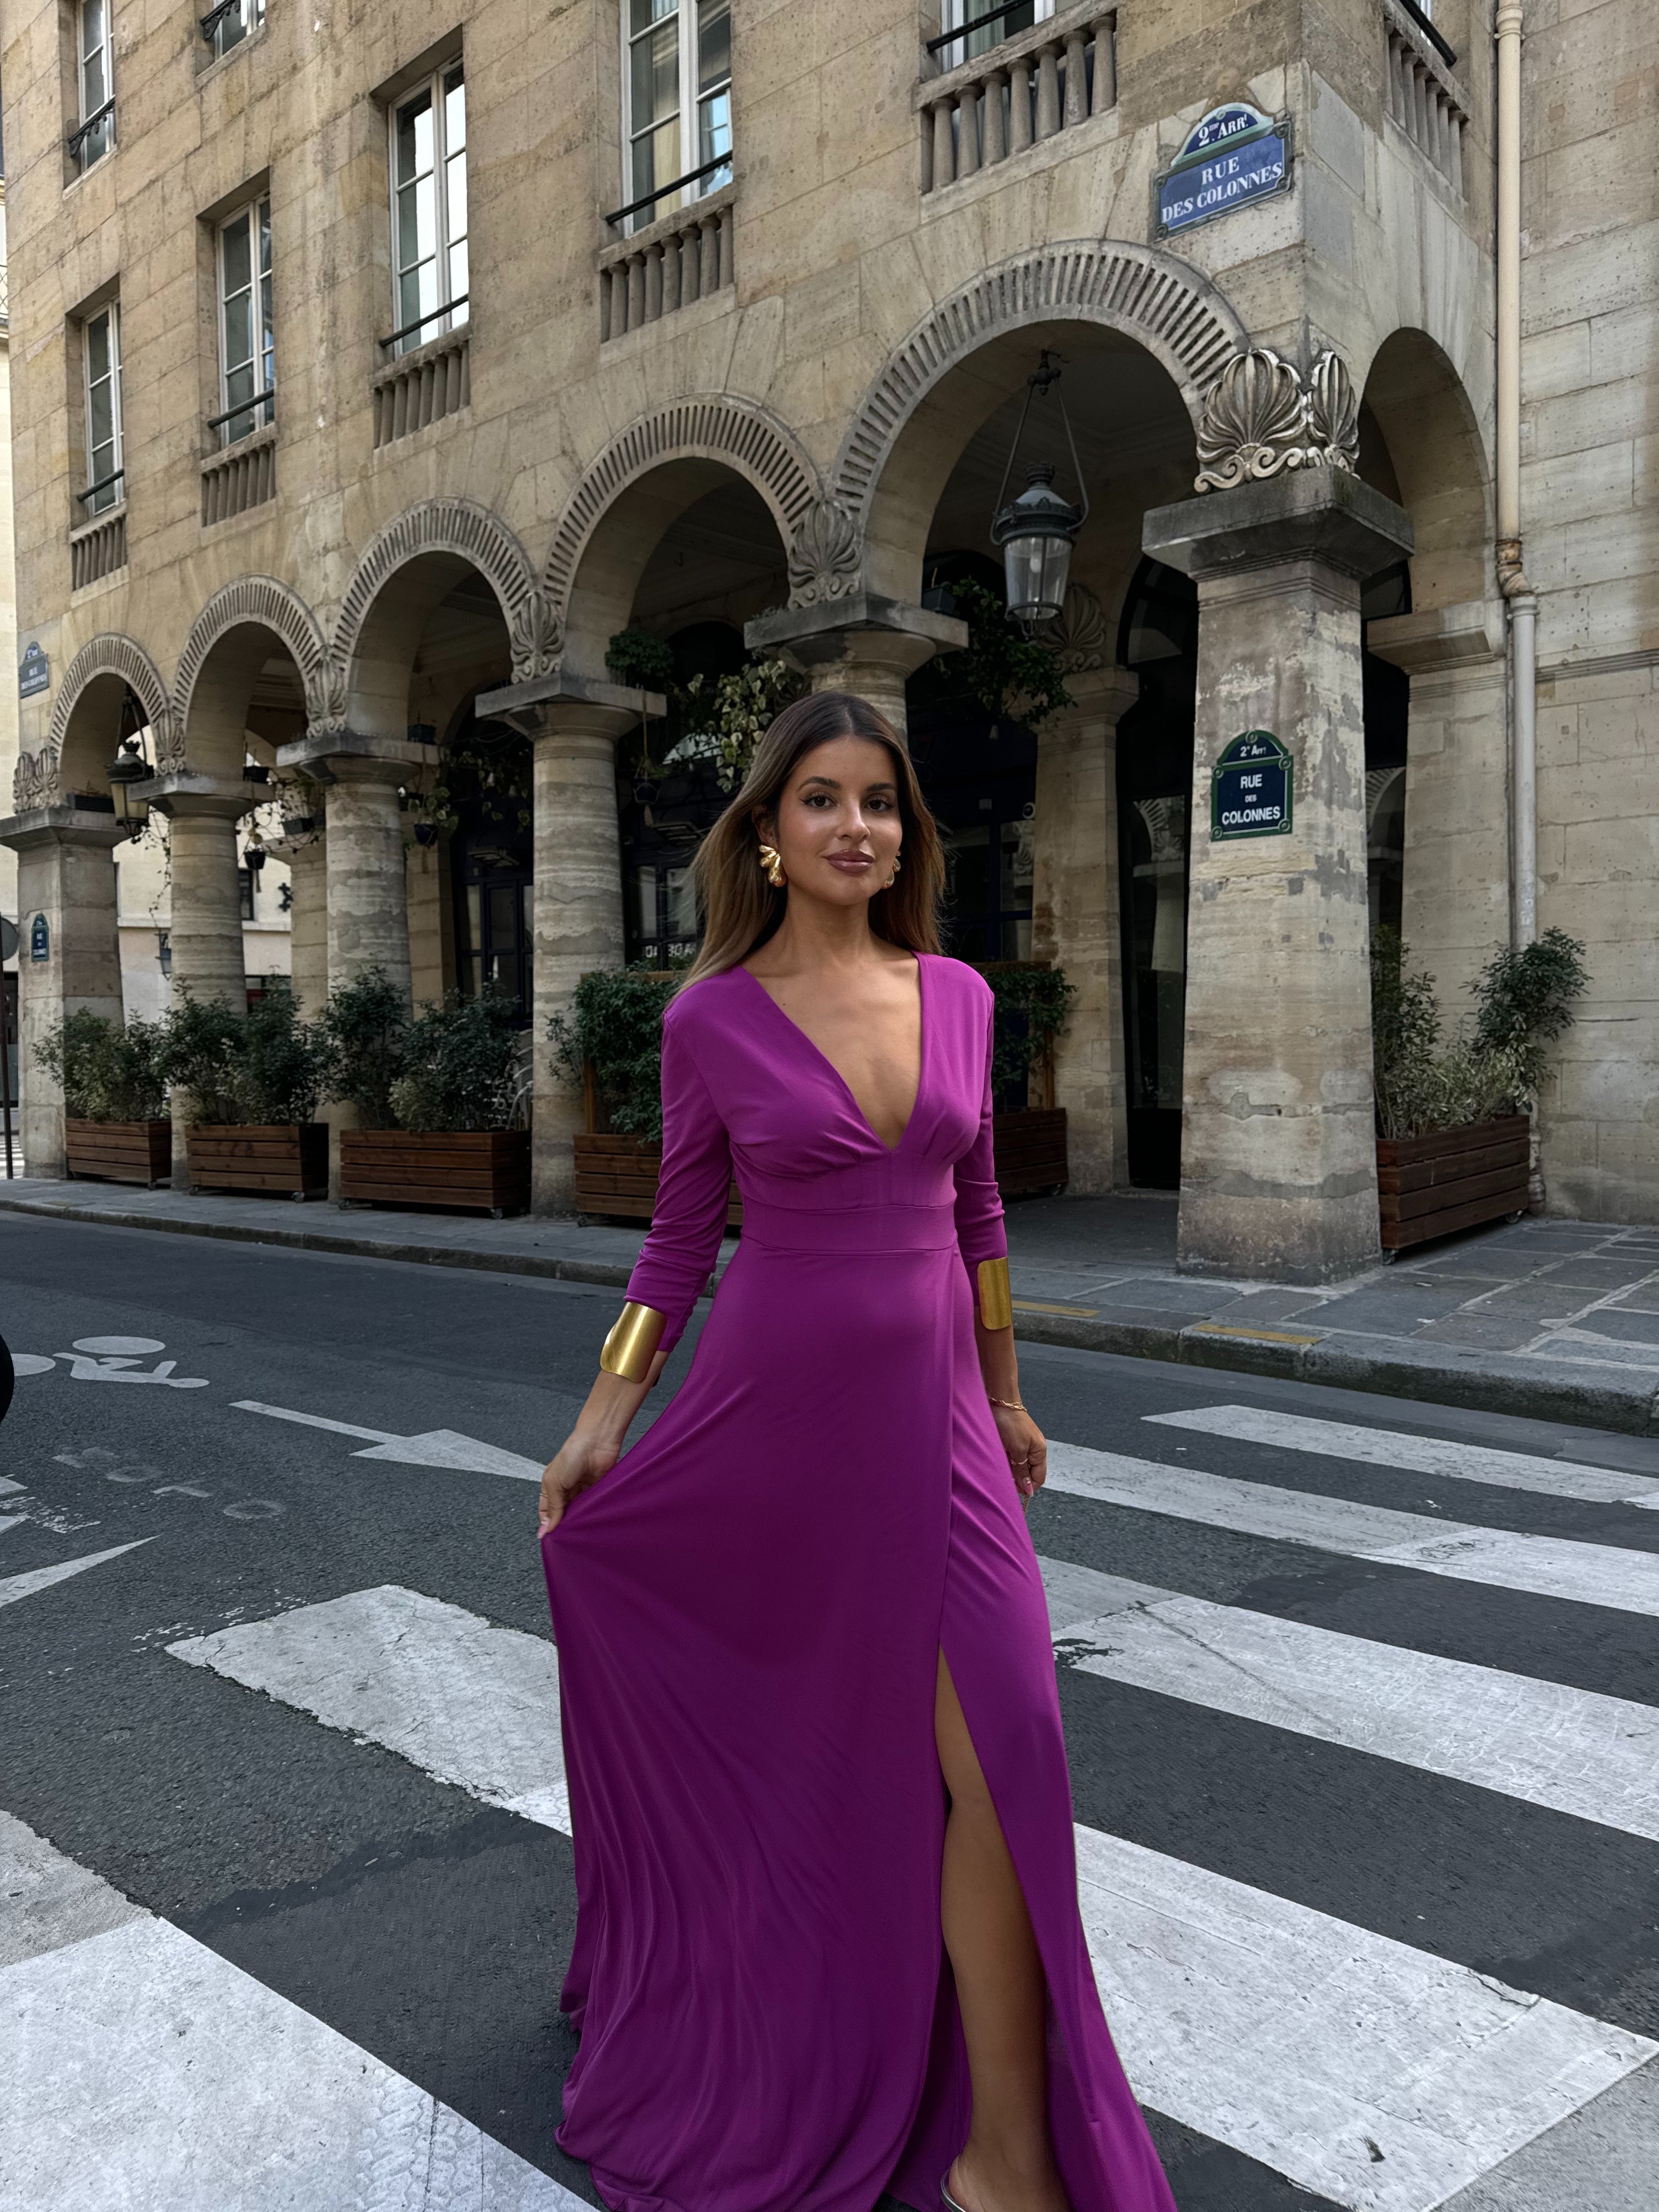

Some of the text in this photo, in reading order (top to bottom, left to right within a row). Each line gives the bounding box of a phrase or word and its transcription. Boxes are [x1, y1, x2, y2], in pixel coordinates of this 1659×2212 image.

[1202, 157, 1239, 184] RUE
[1162, 162, 1282, 222] DES COLONNES
[1240, 774, 1262, 789] RUE
[1245, 794, 1257, 803] DES
[1222, 806, 1280, 825] COLONNES
